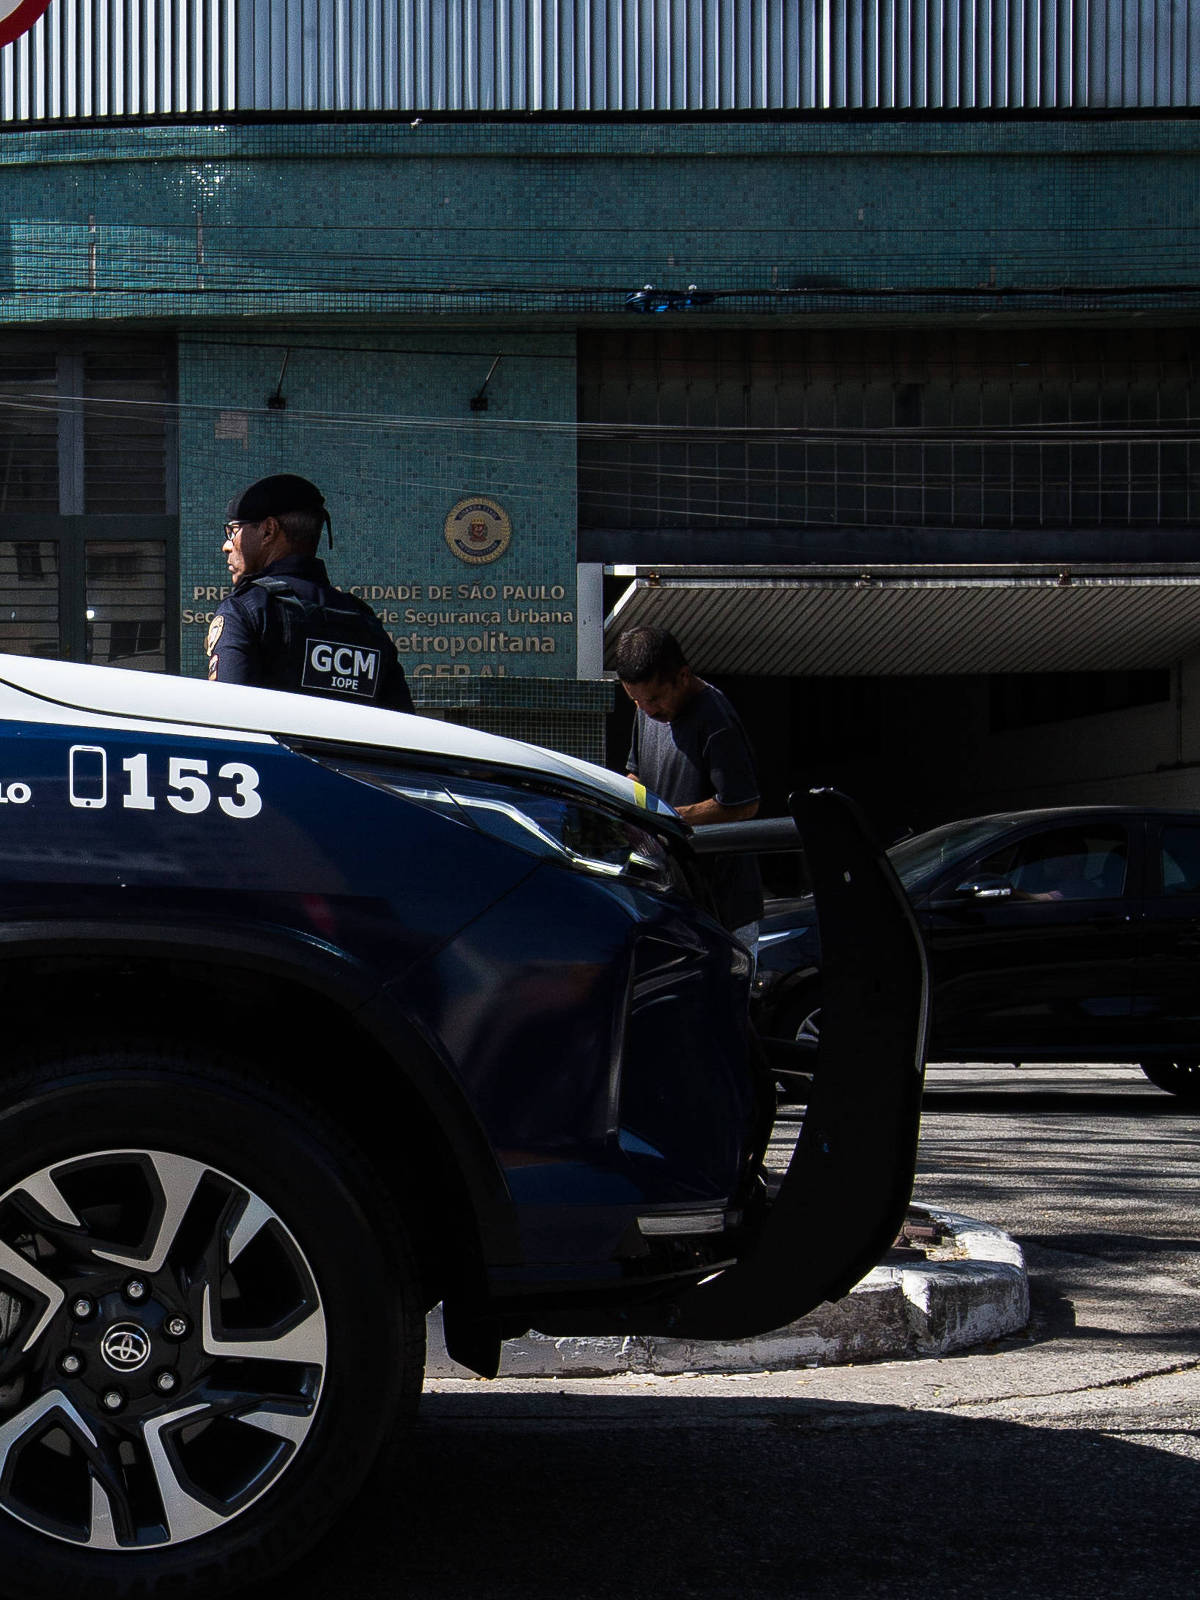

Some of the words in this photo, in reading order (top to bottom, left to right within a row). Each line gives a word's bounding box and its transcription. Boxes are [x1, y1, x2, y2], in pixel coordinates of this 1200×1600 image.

[193, 586, 235, 601] PRE
[350, 585, 421, 600] CIDADE
[429, 586, 451, 600] DE
[458, 581, 497, 601] SÃO
[504, 585, 566, 600] PAULO
[377, 609, 398, 624] de
[404, 609, 500, 627] Segurança
[508, 608, 574, 624] Urbana
[389, 631, 556, 657] etropolitana
[310, 644, 376, 681] GCM
[331, 676, 359, 690] IOPE
[122, 753, 263, 819] 153
